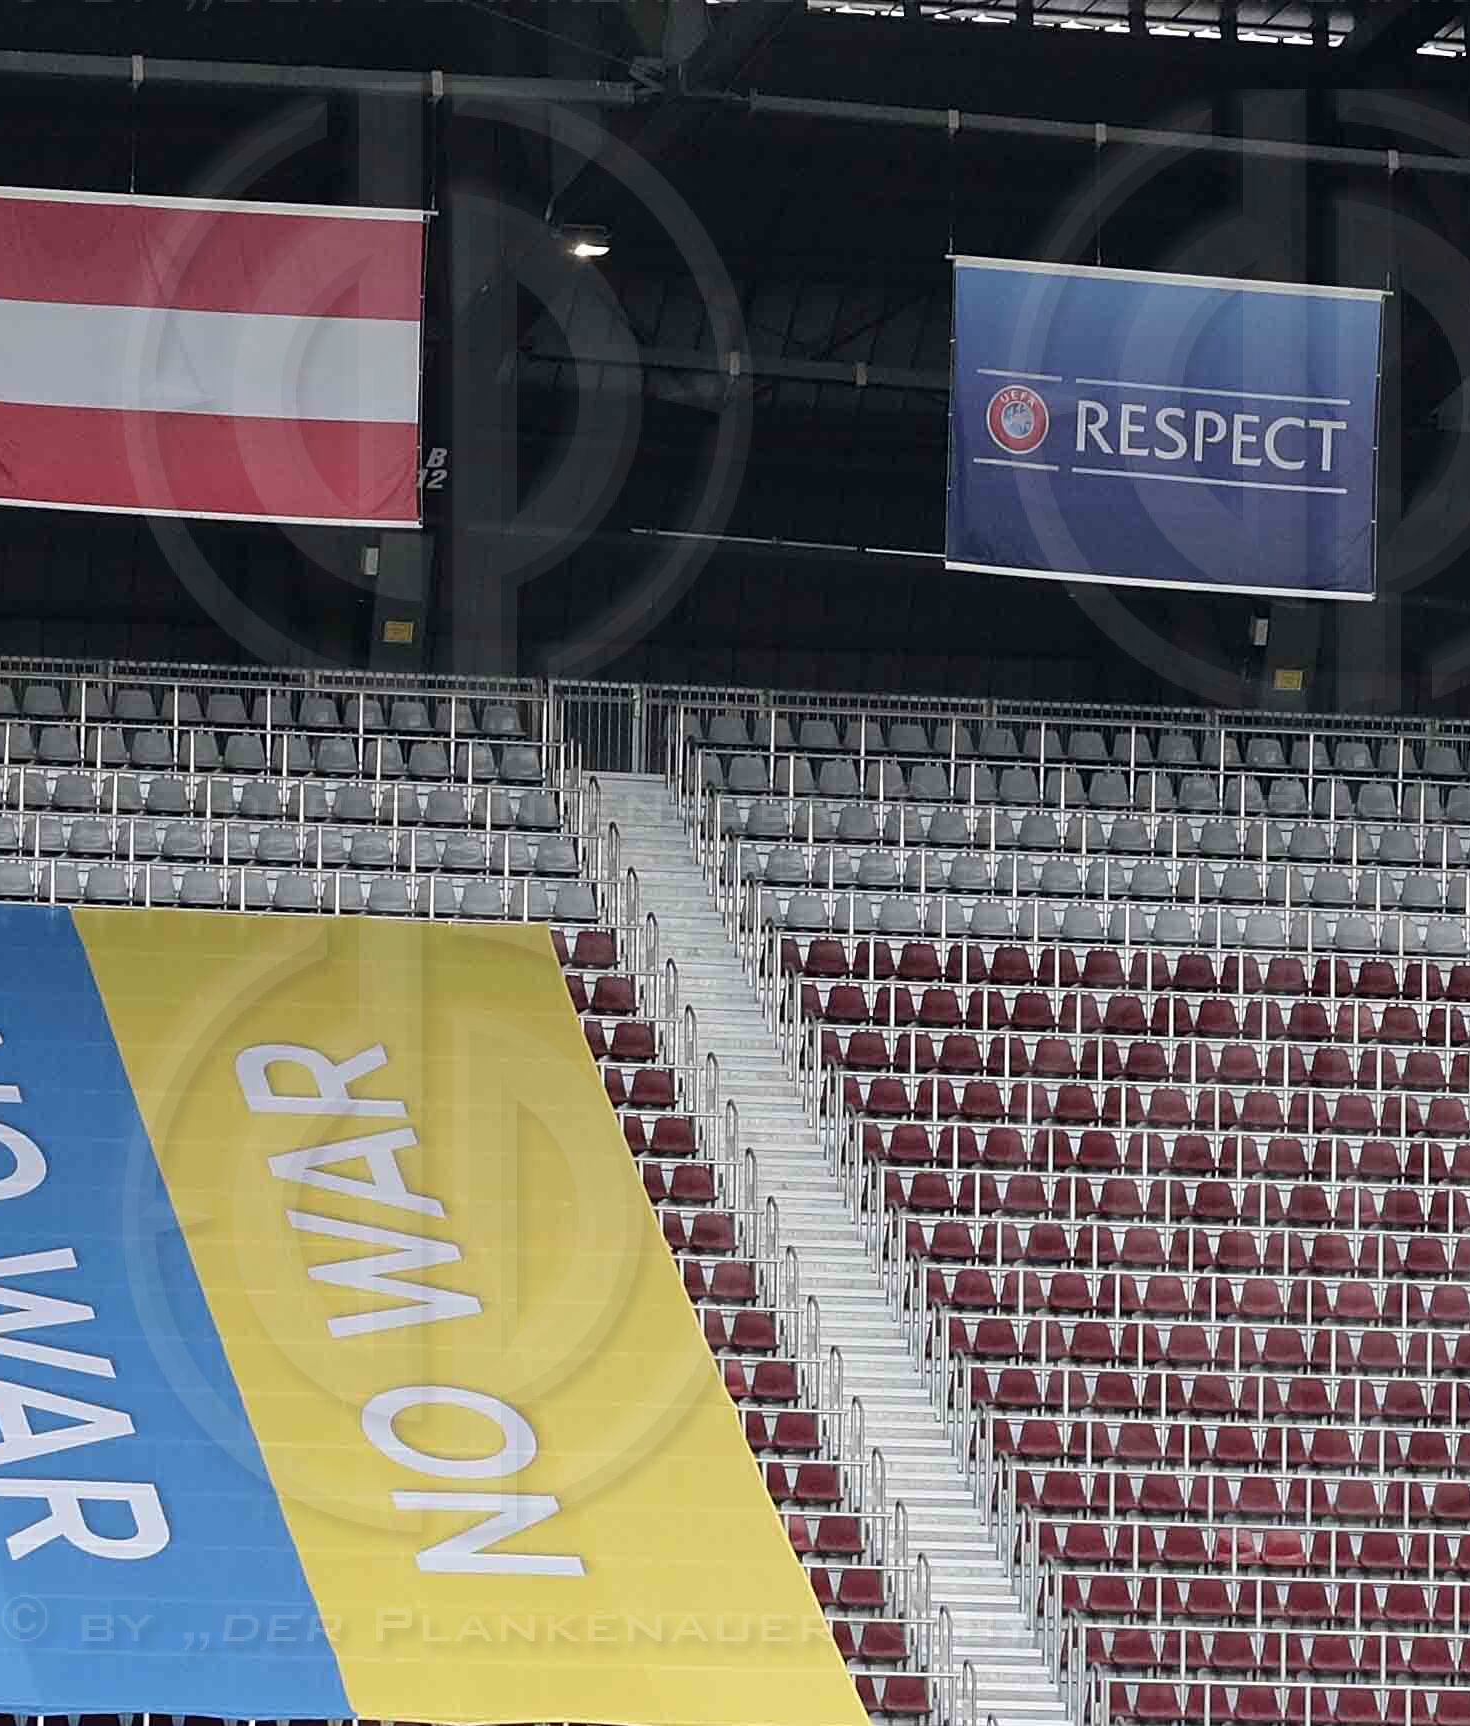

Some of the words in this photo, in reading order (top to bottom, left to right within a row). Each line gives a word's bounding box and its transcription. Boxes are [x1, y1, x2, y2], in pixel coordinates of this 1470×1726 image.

[1075, 399, 1347, 472] RESPECT
[235, 1042, 483, 1339] WAR
[361, 1384, 585, 1577] NO
